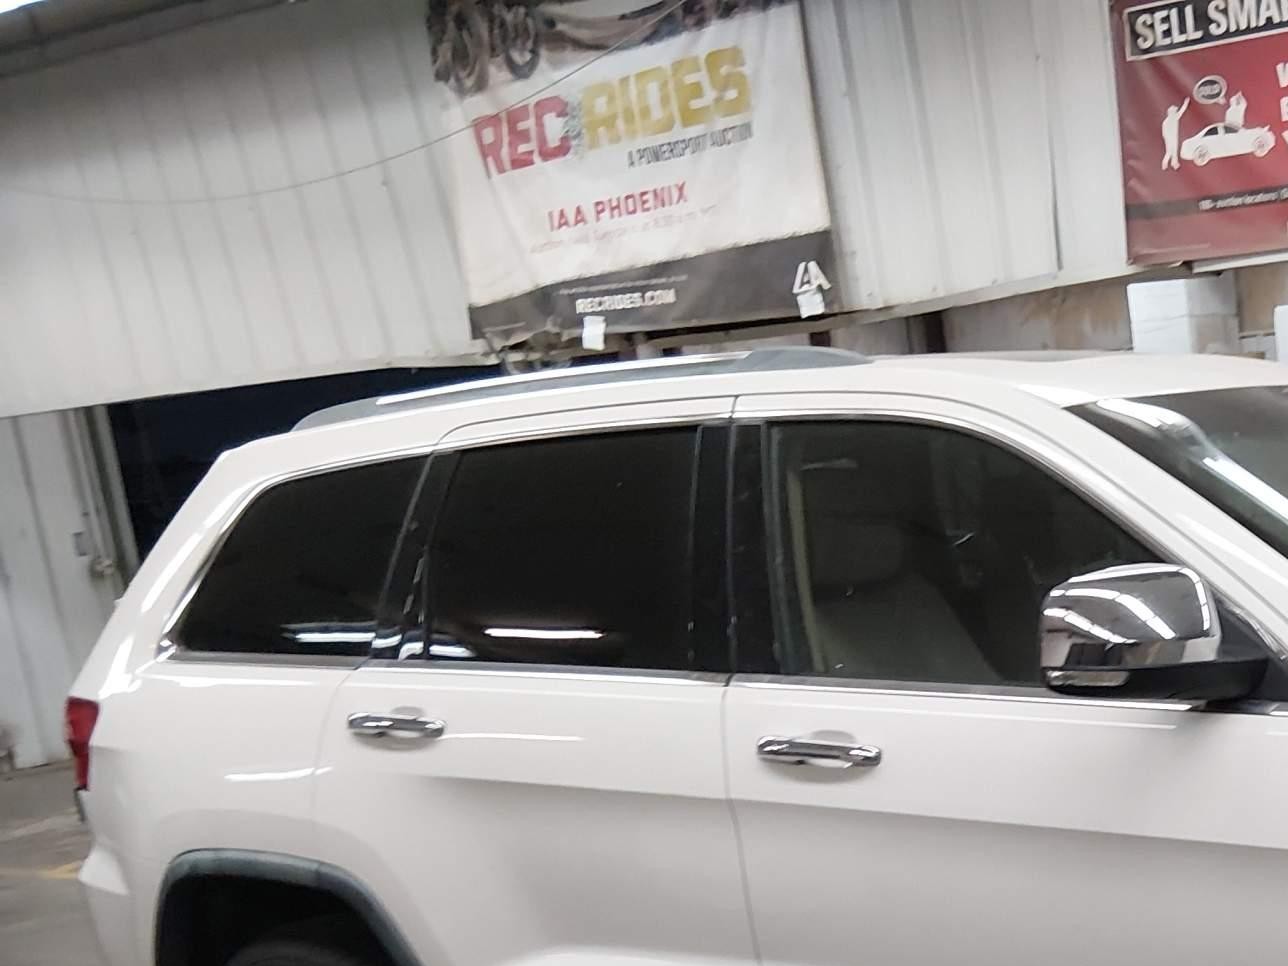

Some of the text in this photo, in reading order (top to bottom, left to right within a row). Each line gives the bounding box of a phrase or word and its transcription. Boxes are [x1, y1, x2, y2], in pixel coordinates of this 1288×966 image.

[1133, 7, 1203, 51] SELL
[472, 46, 753, 179] REC RIDES
[548, 203, 586, 233] IAA
[594, 181, 689, 224] PHOENIX
